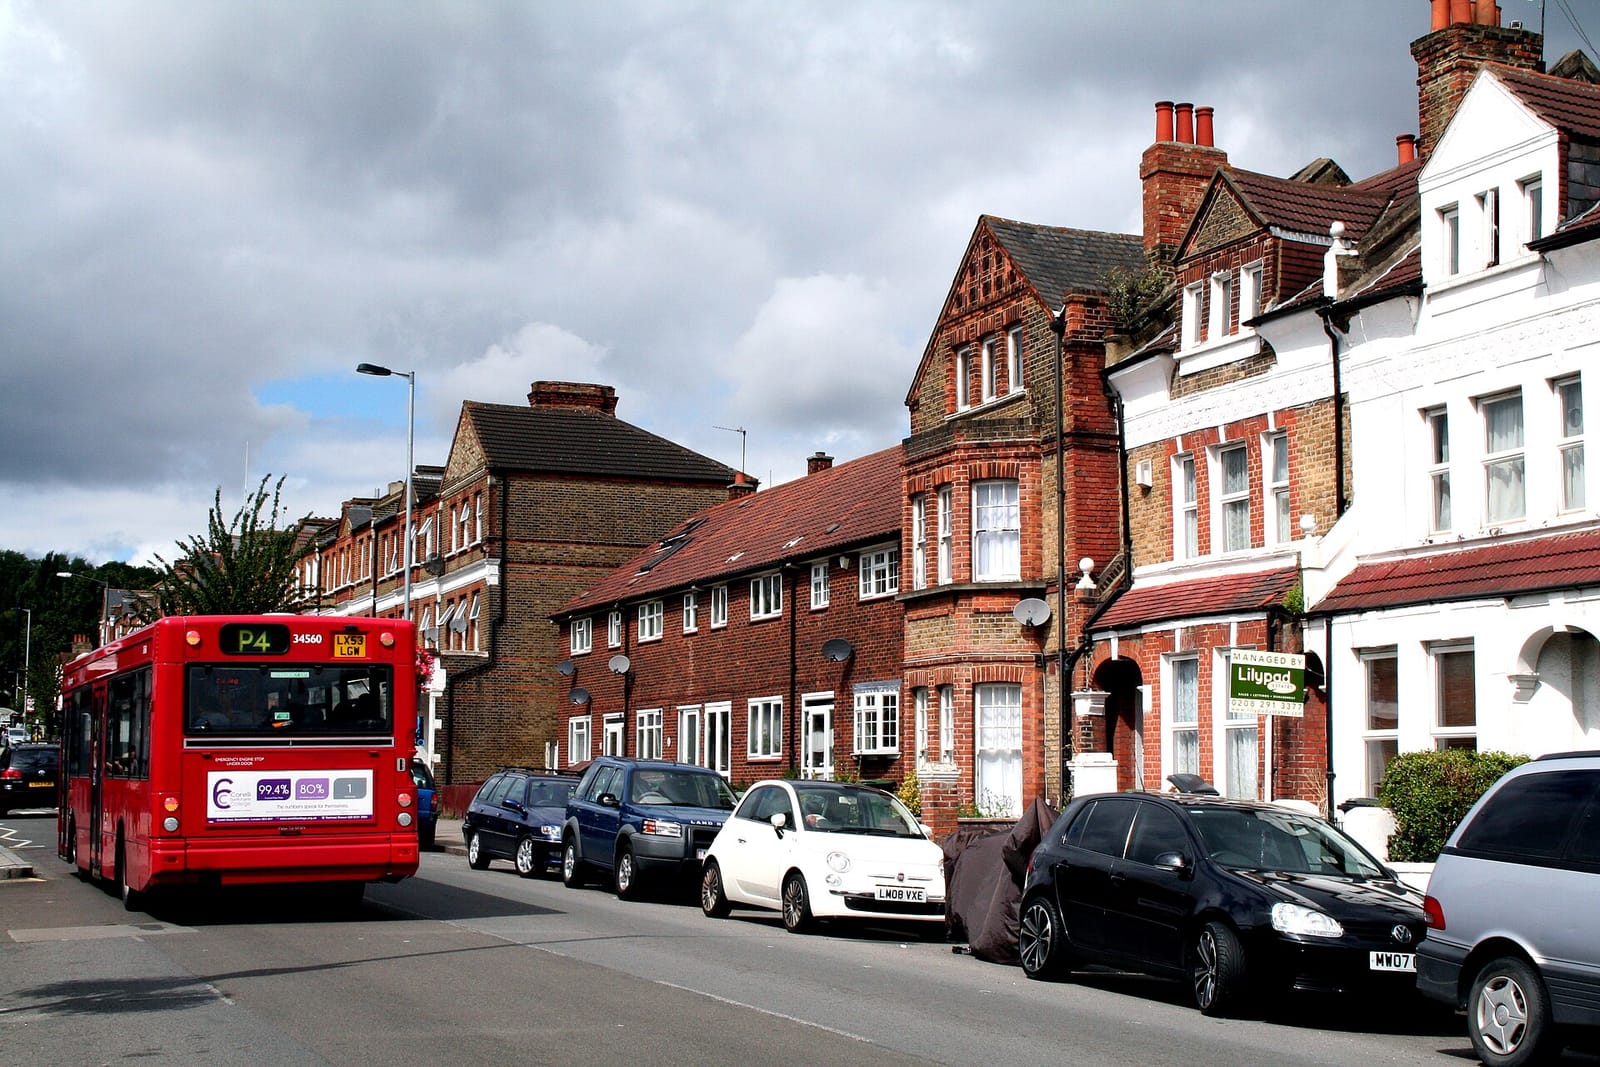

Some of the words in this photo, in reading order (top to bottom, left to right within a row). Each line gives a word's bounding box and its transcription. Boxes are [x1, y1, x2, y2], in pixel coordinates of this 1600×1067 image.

[239, 629, 271, 652] P4
[292, 634, 323, 644] 34560
[336, 635, 364, 645] LX53
[340, 646, 360, 656] LGW
[1233, 653, 1286, 664] MANAGED
[1291, 658, 1303, 666] BY
[1238, 666, 1291, 686] Lilypad
[1231, 699, 1255, 707] 0208
[1281, 702, 1303, 710] 3377
[258, 784, 290, 795] 99.4%
[300, 783, 325, 794] 80%
[880, 888, 904, 899] LM08
[906, 890, 924, 901] VXE
[1376, 953, 1410, 969] MW07
